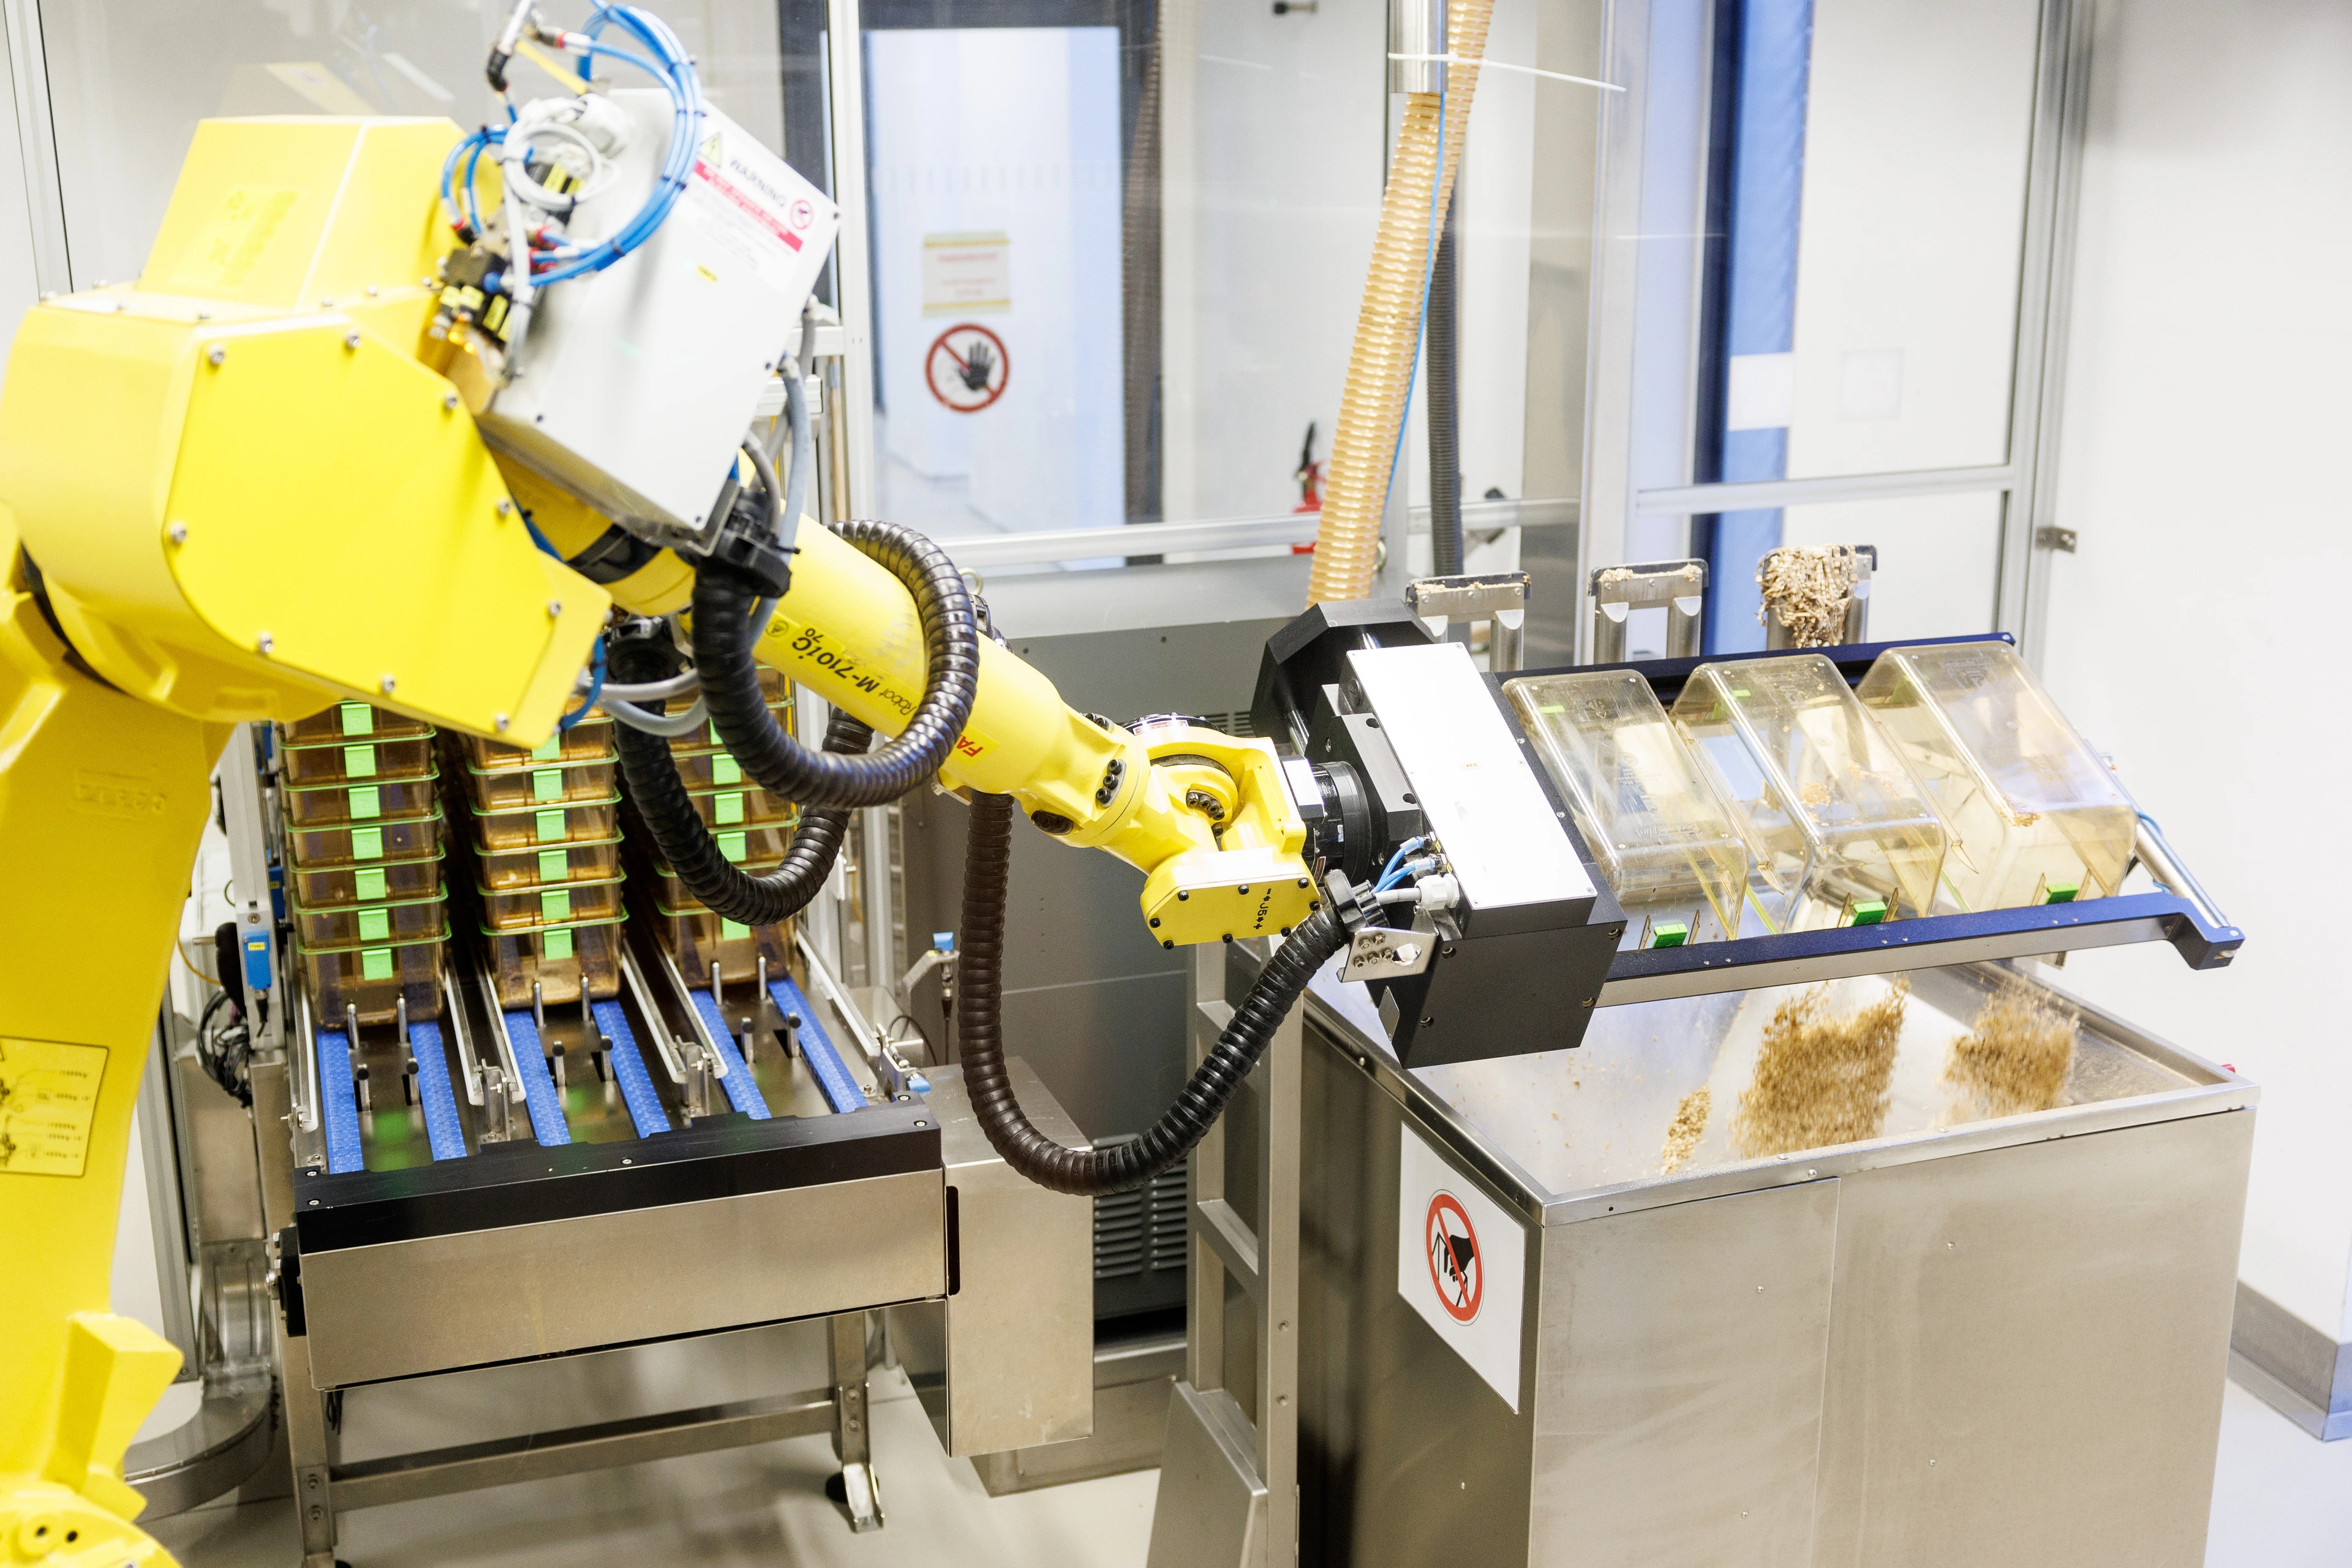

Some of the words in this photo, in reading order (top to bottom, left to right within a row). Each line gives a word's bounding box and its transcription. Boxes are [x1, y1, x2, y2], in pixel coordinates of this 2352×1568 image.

[731, 159, 786, 207] WARNING
[804, 627, 824, 643] 70
[792, 635, 880, 692] M-710iC
[878, 688, 917, 715] Robot
[956, 735, 983, 757] FA
[1257, 902, 1268, 916] J5
